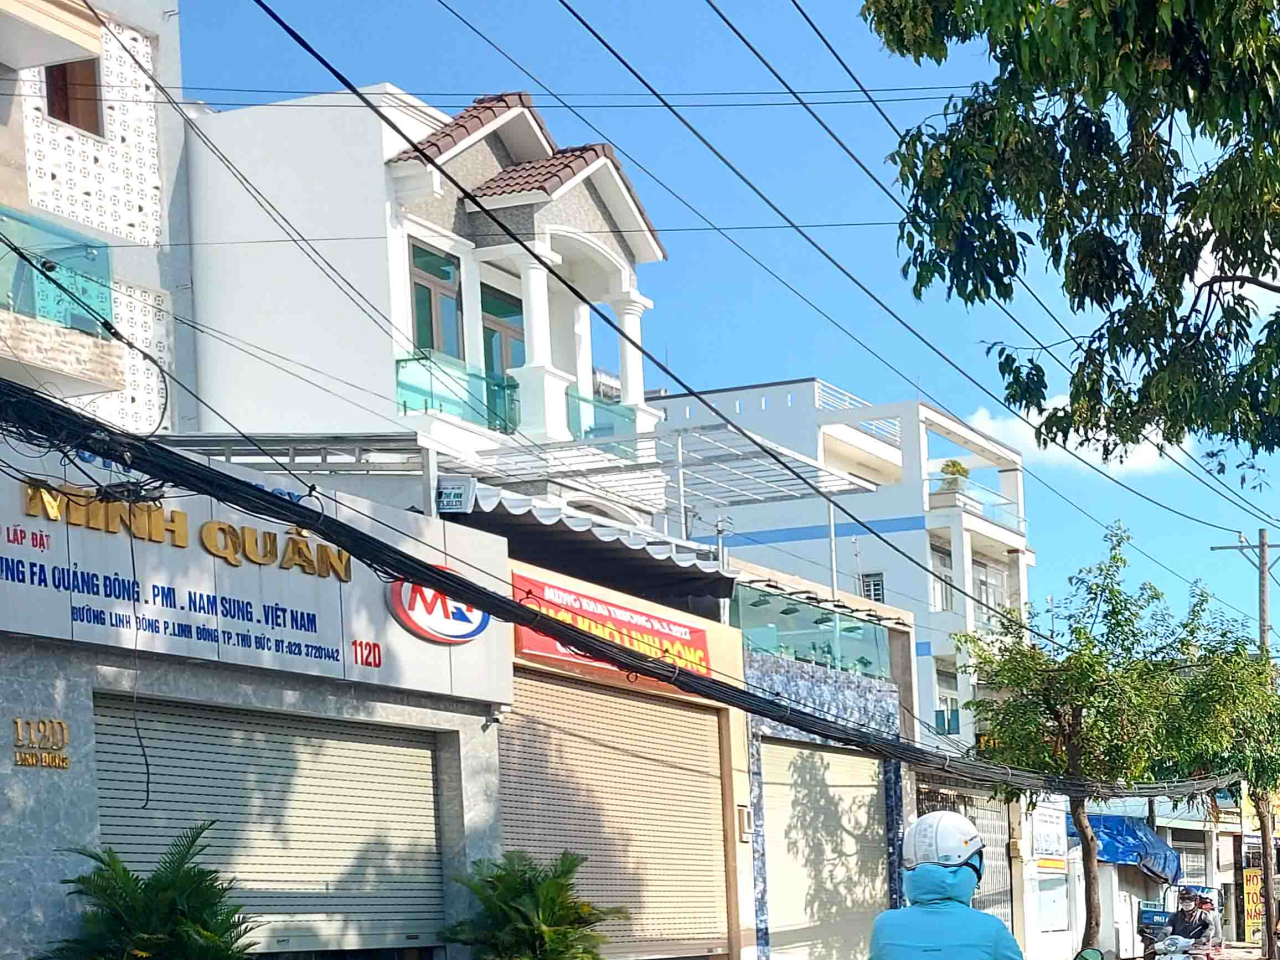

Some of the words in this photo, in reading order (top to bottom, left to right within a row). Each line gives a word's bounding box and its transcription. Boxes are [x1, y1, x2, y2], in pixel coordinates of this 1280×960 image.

[30, 562, 48, 588] FA
[52, 563, 99, 596] QUẢNG
[103, 572, 140, 603] ĐÔNG
[152, 585, 176, 609] PMI
[188, 590, 217, 615] NAM
[220, 597, 253, 622] SUNG
[263, 603, 287, 631] VIỆT
[290, 610, 317, 633] NAM
[72, 604, 105, 625] ĐƯỜNG
[110, 612, 131, 629] LINH
[136, 614, 160, 633] ĐÔNG
[196, 624, 218, 642] ĐÔNG
[255, 634, 271, 651] ĐỨC
[305, 644, 340, 661] 37201442
[351, 639, 382, 668] 112D
